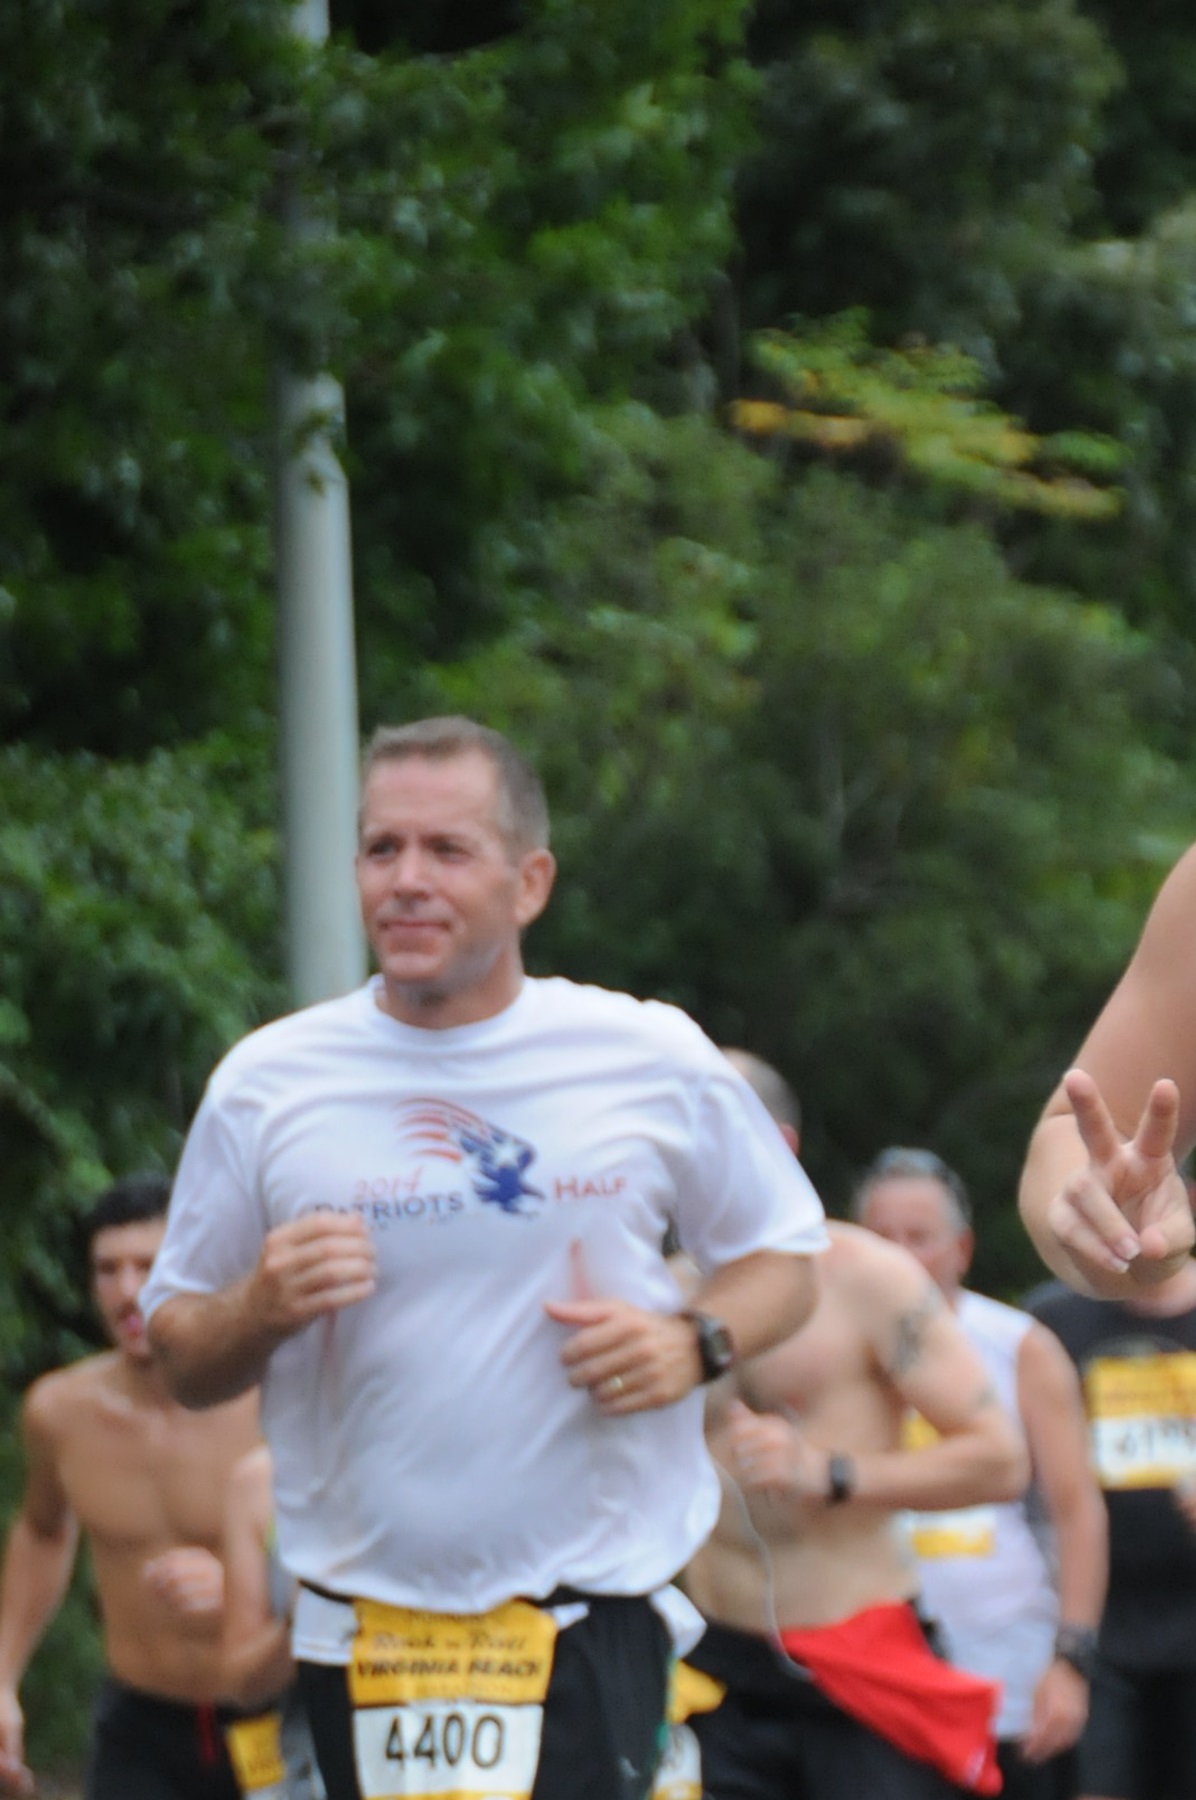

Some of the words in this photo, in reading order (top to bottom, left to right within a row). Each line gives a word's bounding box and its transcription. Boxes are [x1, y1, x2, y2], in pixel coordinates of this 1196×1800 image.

[313, 1190, 464, 1219] TRIOTS
[553, 1174, 627, 1201] HALF
[384, 1711, 504, 1771] 4400
